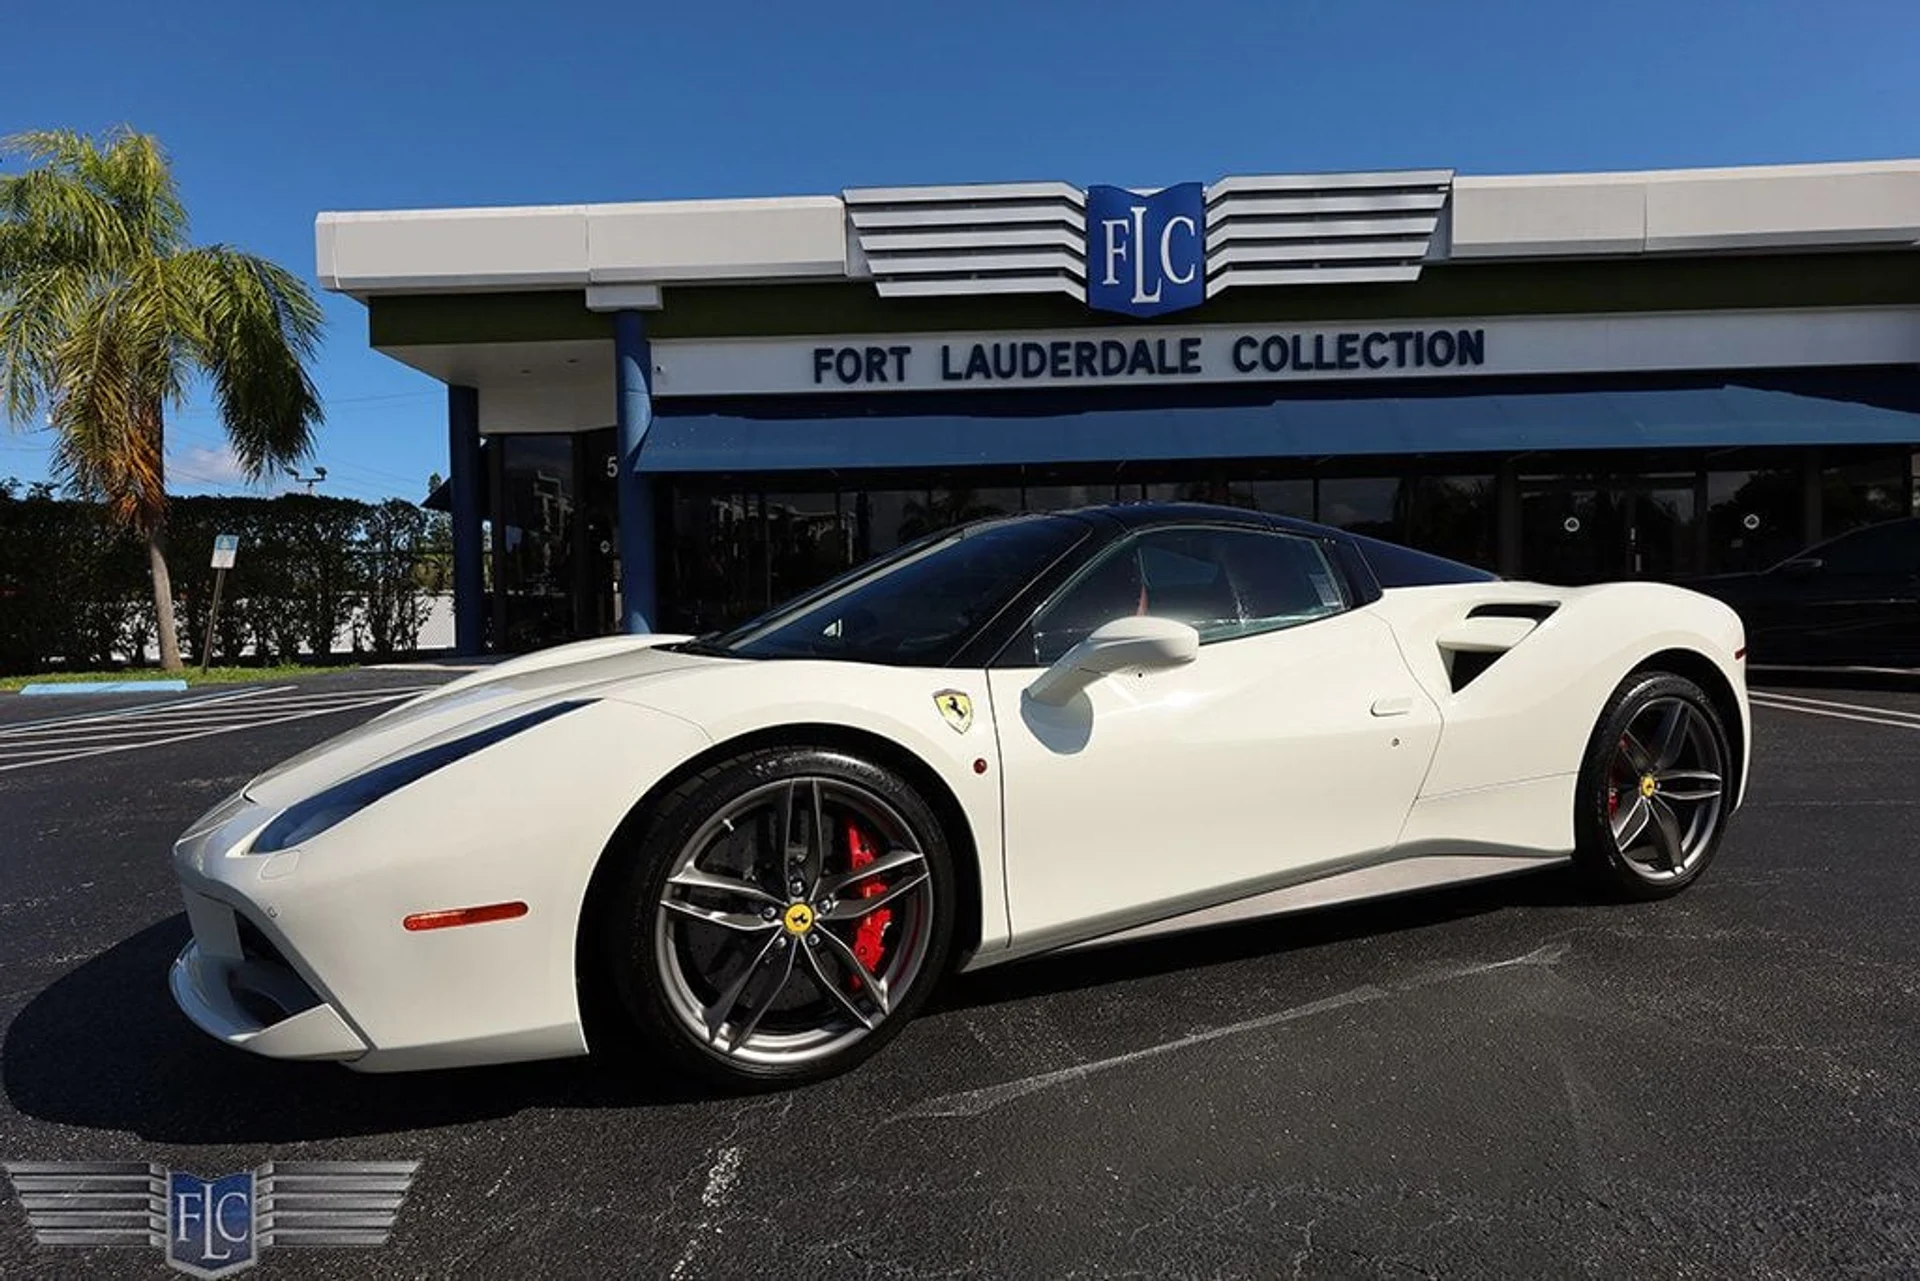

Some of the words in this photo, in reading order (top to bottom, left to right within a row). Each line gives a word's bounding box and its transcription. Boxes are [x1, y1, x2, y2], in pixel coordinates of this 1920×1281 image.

[1102, 206, 1196, 303] FLC
[813, 346, 911, 384] FORT
[941, 337, 1202, 381] LAUDERDALE
[1232, 329, 1485, 374] COLLECTION
[607, 456, 618, 477] 5
